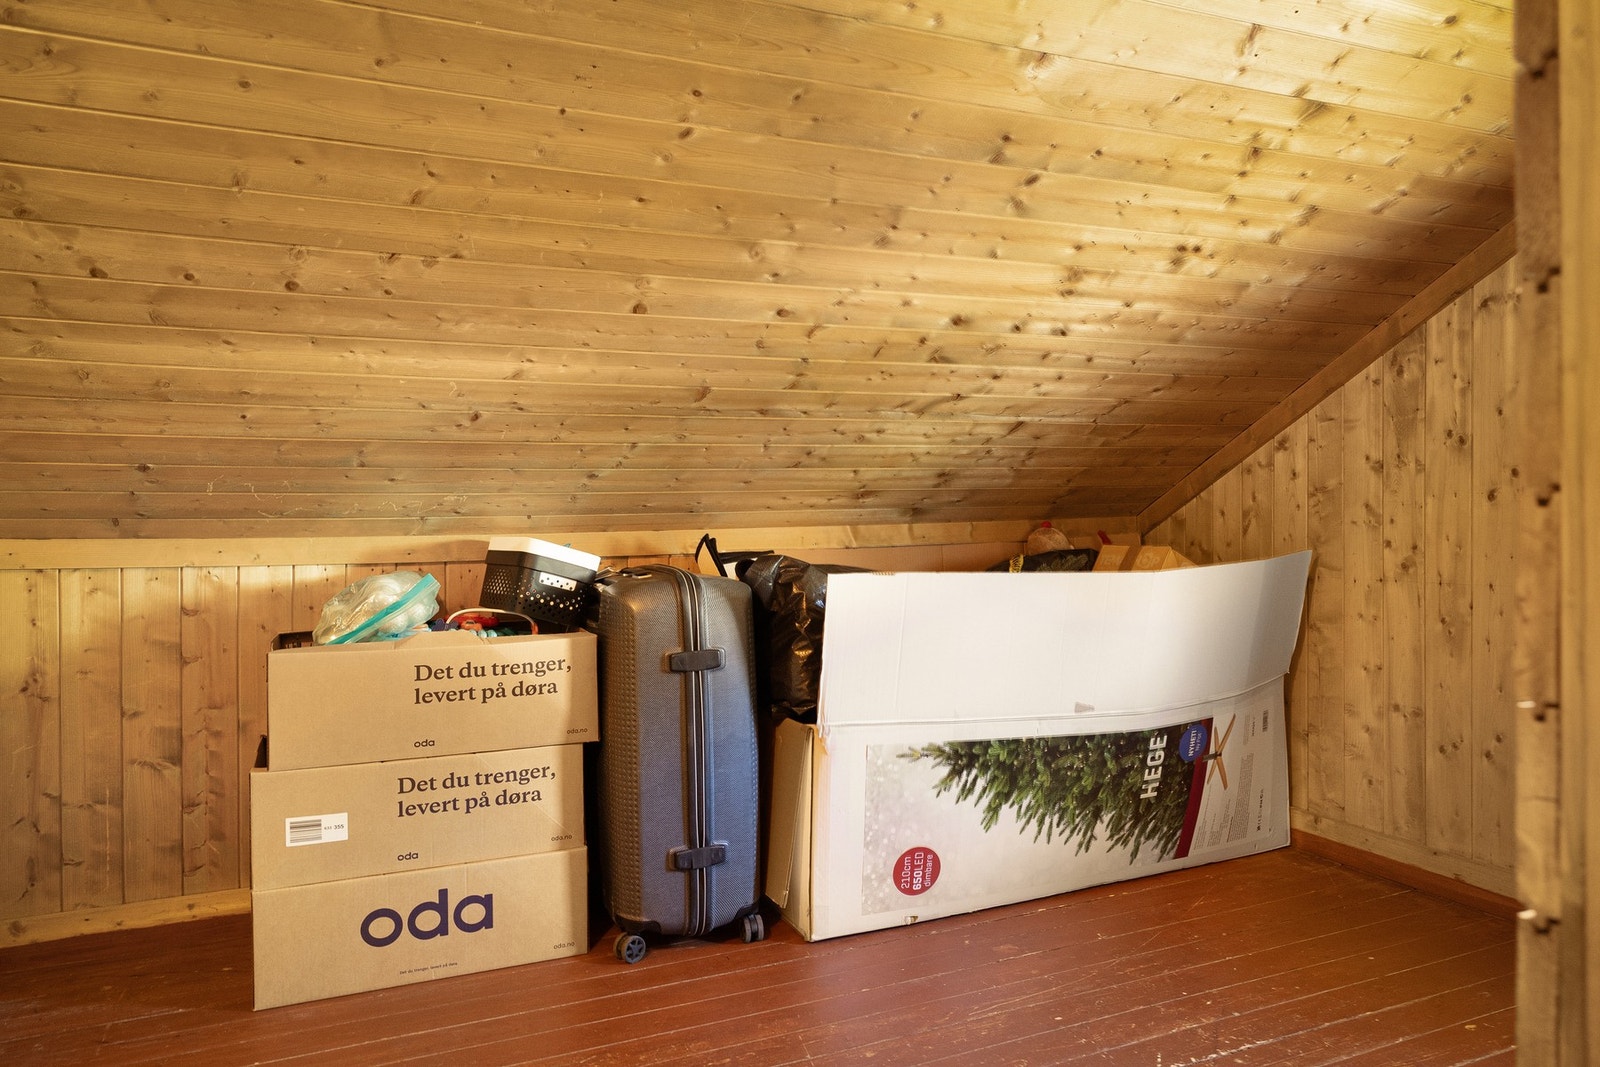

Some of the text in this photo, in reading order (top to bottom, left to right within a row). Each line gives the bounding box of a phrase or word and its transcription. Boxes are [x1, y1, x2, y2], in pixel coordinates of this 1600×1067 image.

[414, 658, 572, 682] Det du trenger,
[414, 680, 559, 705] levert på døra
[413, 738, 436, 748] oda
[566, 727, 589, 736] oda.no
[397, 765, 556, 795] Det du trenger,
[1140, 735, 1168, 798] HEGE
[397, 788, 543, 818] levert på døra
[550, 834, 573, 843] oda.no
[396, 851, 419, 862] oda
[901, 856, 911, 889] 210cm
[913, 852, 924, 890] 650LED
[923, 854, 934, 887] dimbare
[360, 888, 494, 948] oda
[553, 940, 576, 951] oda.no
